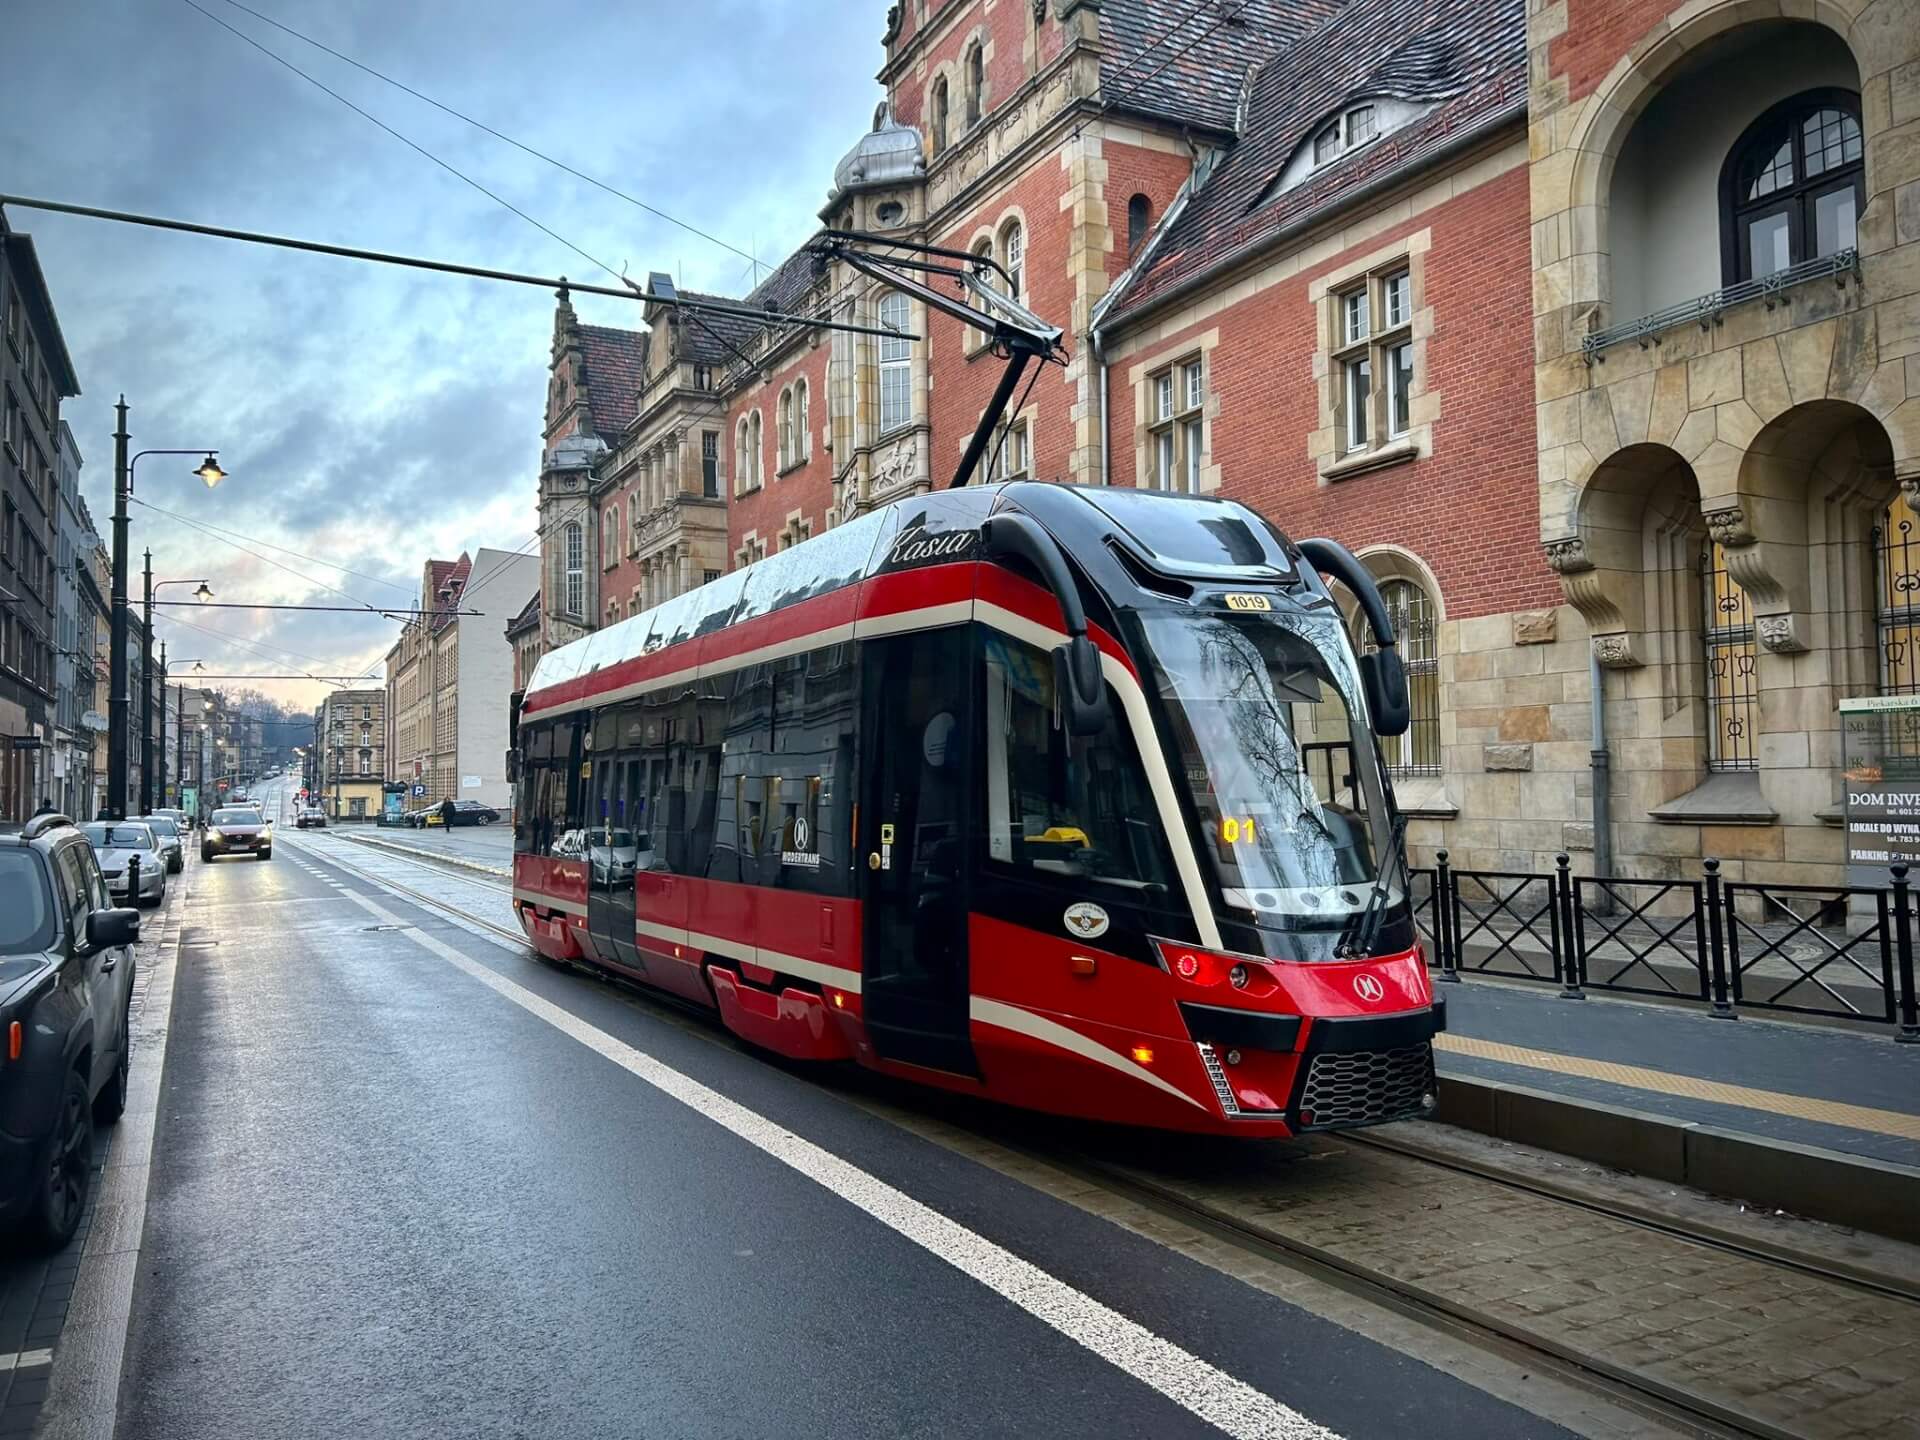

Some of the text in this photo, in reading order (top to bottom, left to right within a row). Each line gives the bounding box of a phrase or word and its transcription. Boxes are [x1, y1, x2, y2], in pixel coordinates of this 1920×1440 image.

[881, 525, 975, 563] Kasia
[1231, 596, 1265, 608] 1019
[1849, 793, 1885, 805] DOM
[1223, 816, 1255, 843] 01
[1849, 823, 1879, 833] LOKALE
[1880, 824, 1892, 833] DO
[1850, 849, 1889, 861] PARKING
